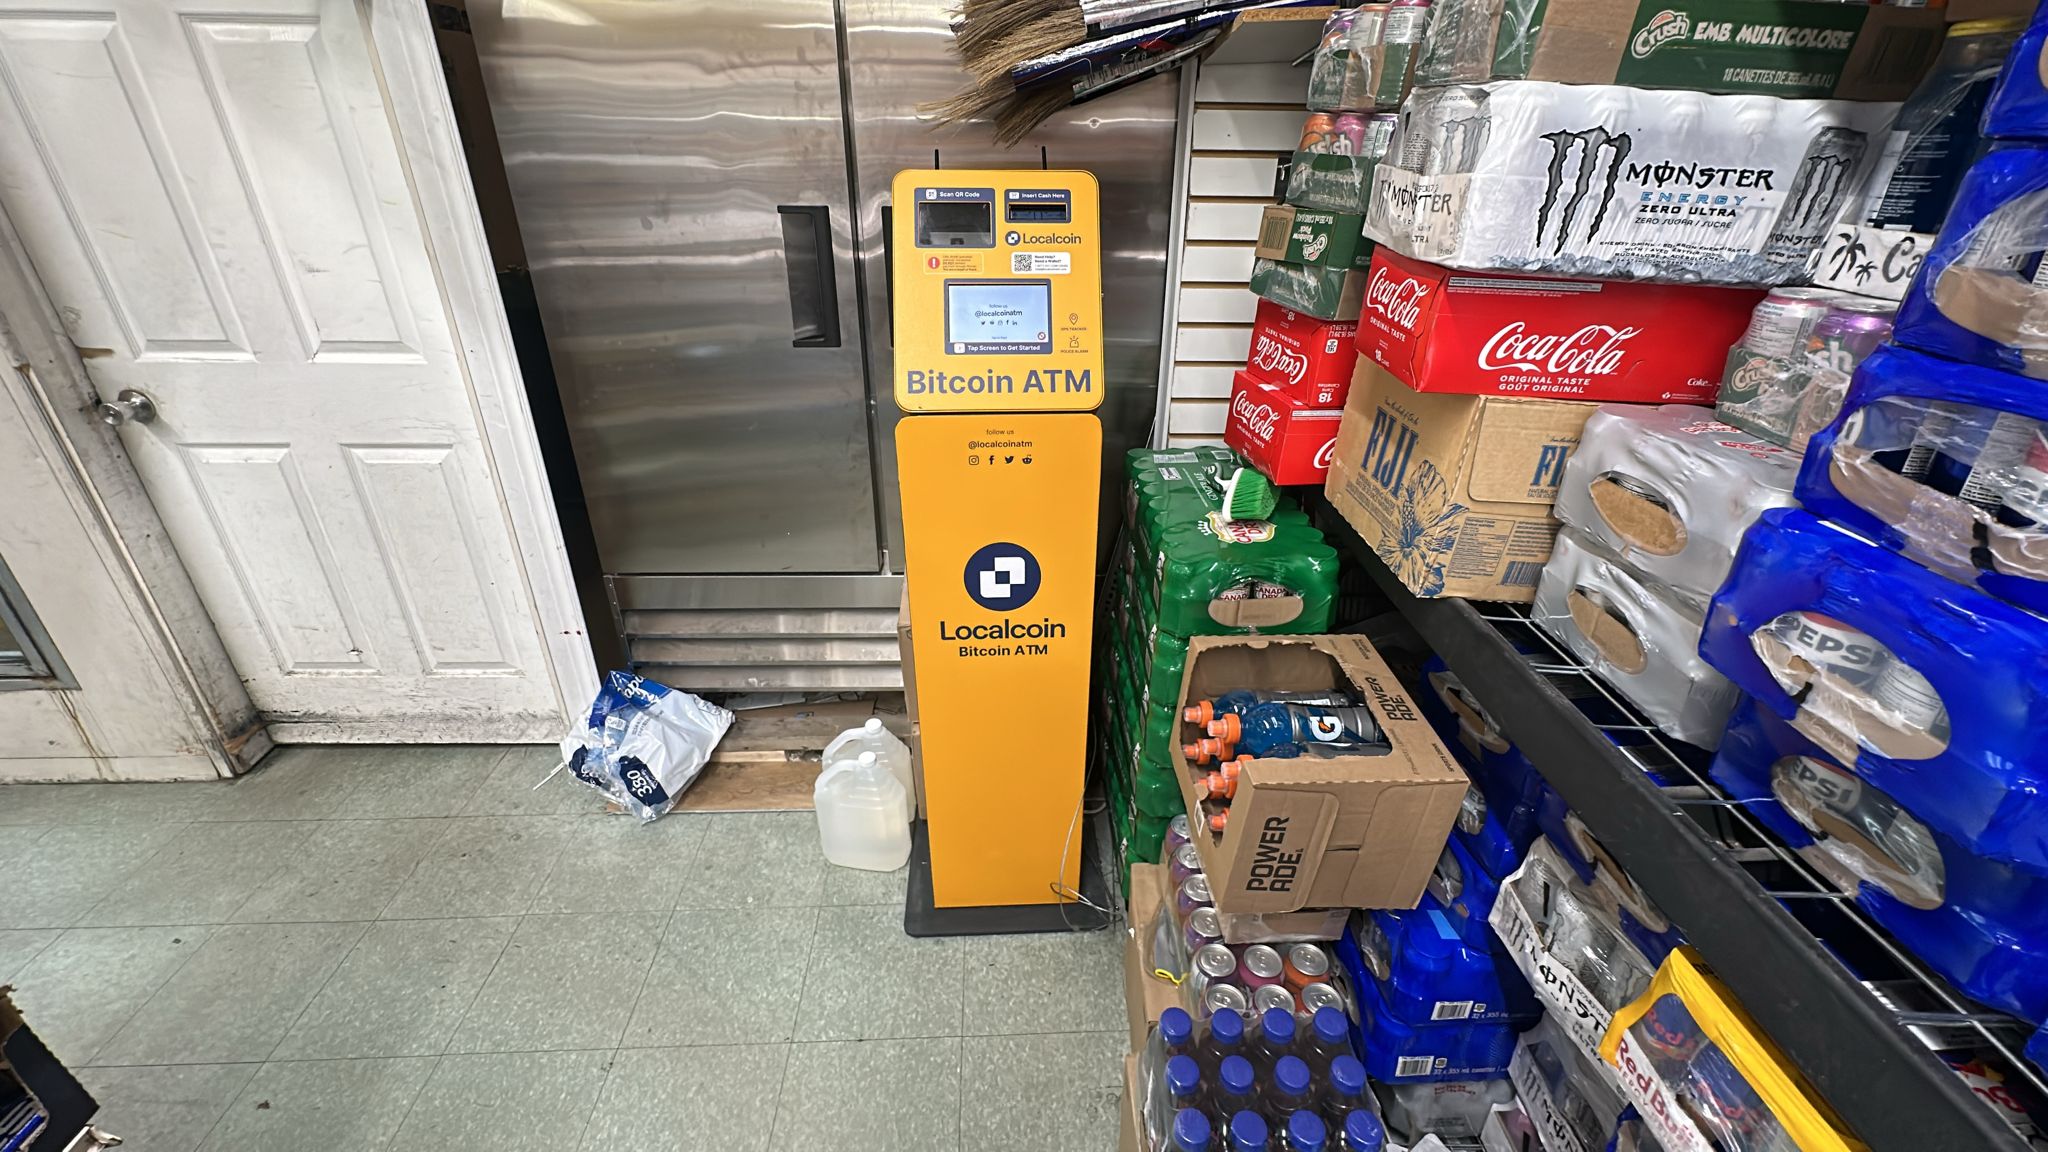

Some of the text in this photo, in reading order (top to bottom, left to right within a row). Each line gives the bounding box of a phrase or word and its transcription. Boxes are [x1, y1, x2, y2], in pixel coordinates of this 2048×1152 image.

[1633, 12, 1854, 57] Crush EMB. MULTICOLORE
[1723, 68, 1731, 82] 18
[1731, 68, 1773, 83] CANETTES
[1774, 70, 1787, 83] DE
[1639, 205, 1737, 217] ZERO ULTRA
[1641, 192, 1747, 206] ENERGY
[1635, 217, 1660, 225] ZERO
[1661, 218, 1693, 226] SUGAR
[1023, 232, 1082, 244] Localcoin
[1367, 266, 1431, 330] Coca-Cola
[1265, 327, 1300, 348] ORIGINAL TASTE
[1370, 316, 1406, 342] ORIGINAL TASTE
[1252, 334, 1308, 385] Coca-Cola
[1478, 322, 1644, 375] Coca-Cola
[907, 369, 1092, 394] Bitcoin ATM
[1498, 382, 1585, 394] GOÛT ORIGINAL
[1500, 375, 1592, 386] ORIGINAL TASTE
[1687, 378, 1708, 386] Coke
[1318, 392, 1333, 403] 18
[1232, 390, 1281, 441] Coca-Cola
[968, 440, 1033, 450] @localcoinatm
[1236, 423, 1265, 449] ORIGINAL TASTE
[1360, 406, 1420, 499] FIJI
[940, 618, 1066, 641] Localcoin
[959, 644, 1048, 657] Bitcoin ATM
[1365, 677, 1403, 721] POWER
[1309, 716, 1342, 742] G
[627, 770, 653, 798] 380
[1246, 816, 1290, 892] POWER
[1618, 1038, 1653, 1094] Red
